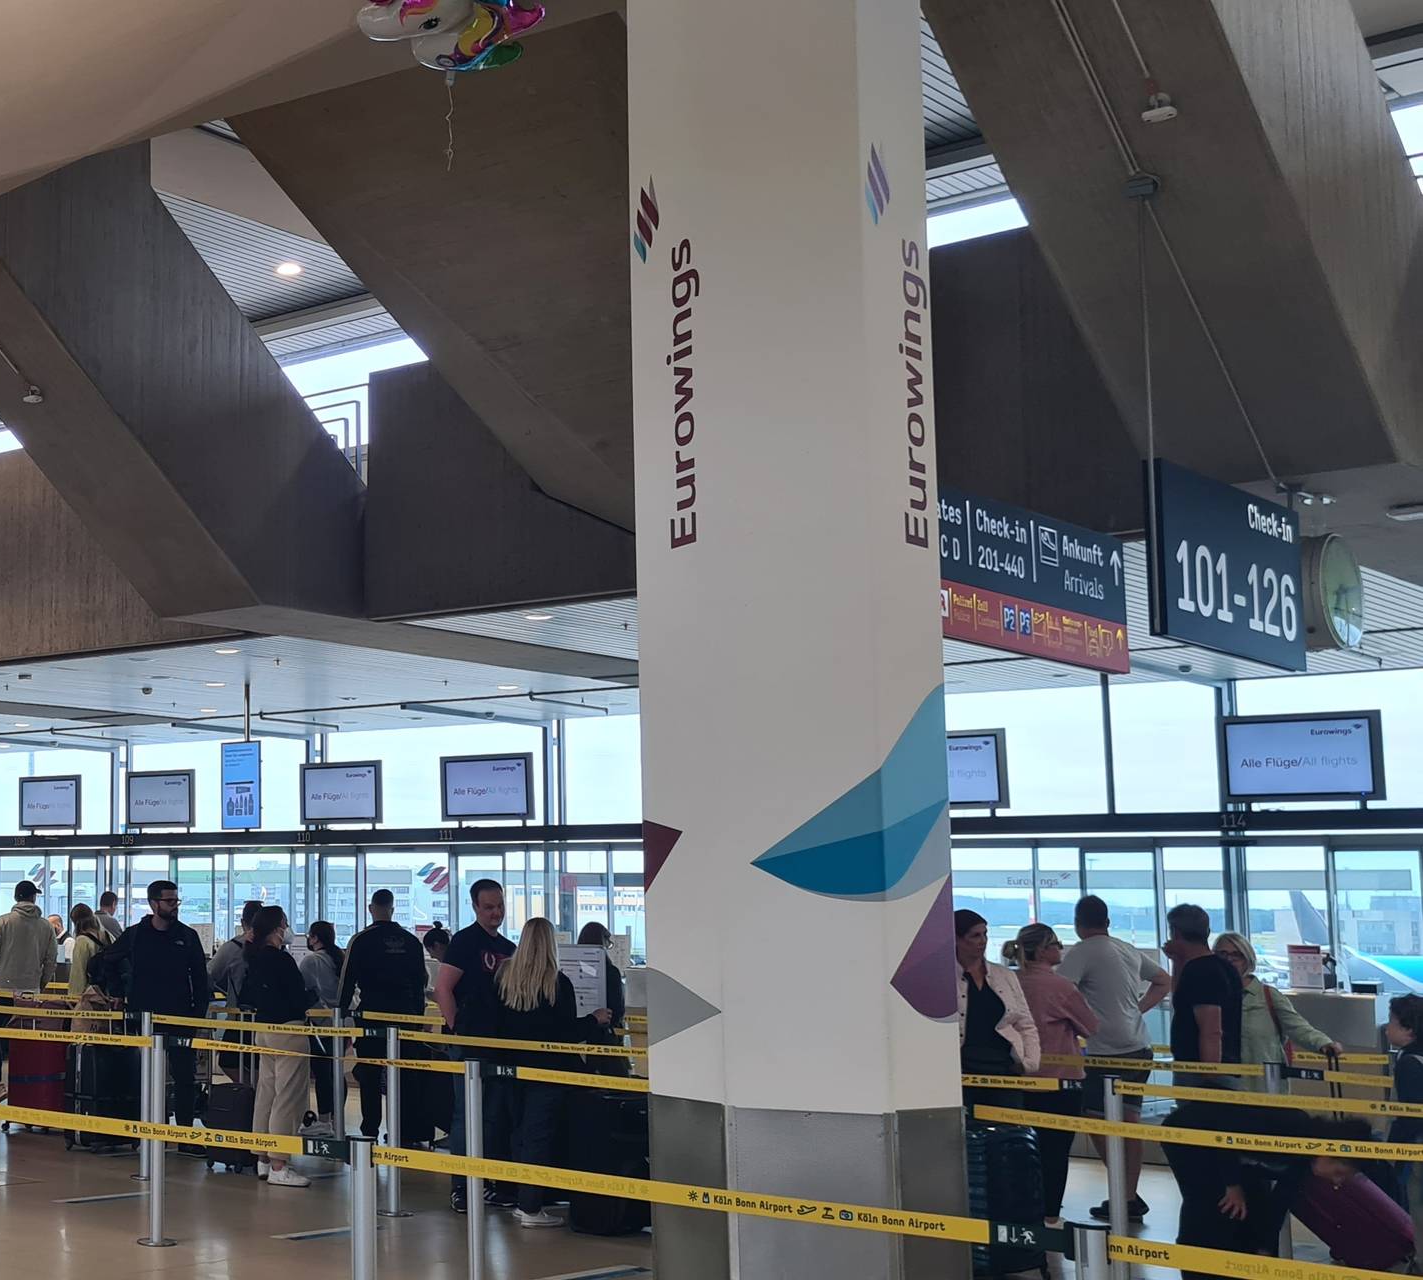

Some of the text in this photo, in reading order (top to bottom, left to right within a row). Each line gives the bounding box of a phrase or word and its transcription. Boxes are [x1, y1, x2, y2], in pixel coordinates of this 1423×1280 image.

[666, 238, 700, 549] Eurowings
[898, 238, 929, 549] Eurowings
[976, 508, 1027, 544] Check-in
[1247, 503, 1293, 543] Check-in
[952, 538, 960, 560] D
[1062, 535, 1104, 567] Ankunft
[978, 546, 1025, 579] 201-440
[1064, 569, 1104, 600] Arrivals
[1176, 540, 1297, 641] 101-126
[1310, 728, 1352, 736] Eurowings
[1241, 758, 1261, 768] Alle
[1321, 755, 1358, 768] flights
[957, 769, 986, 779] flights
[1220, 814, 1246, 828] 114
[122, 836, 134, 844] 109
[297, 832, 310, 842] 110
[439, 830, 453, 840] 111
[1007, 877, 1058, 887] Eurongs
[167, 1129, 188, 1140] Airport
[255, 1137, 278, 1148] Airport
[384, 1152, 409, 1163] Airport
[1274, 1140, 1302, 1150] Airport
[1396, 1148, 1423, 1157] Airport
[713, 1195, 945, 1232] Köln Bonn Airport Köln Bonn Airport
[1127, 1246, 1170, 1261] Airport
